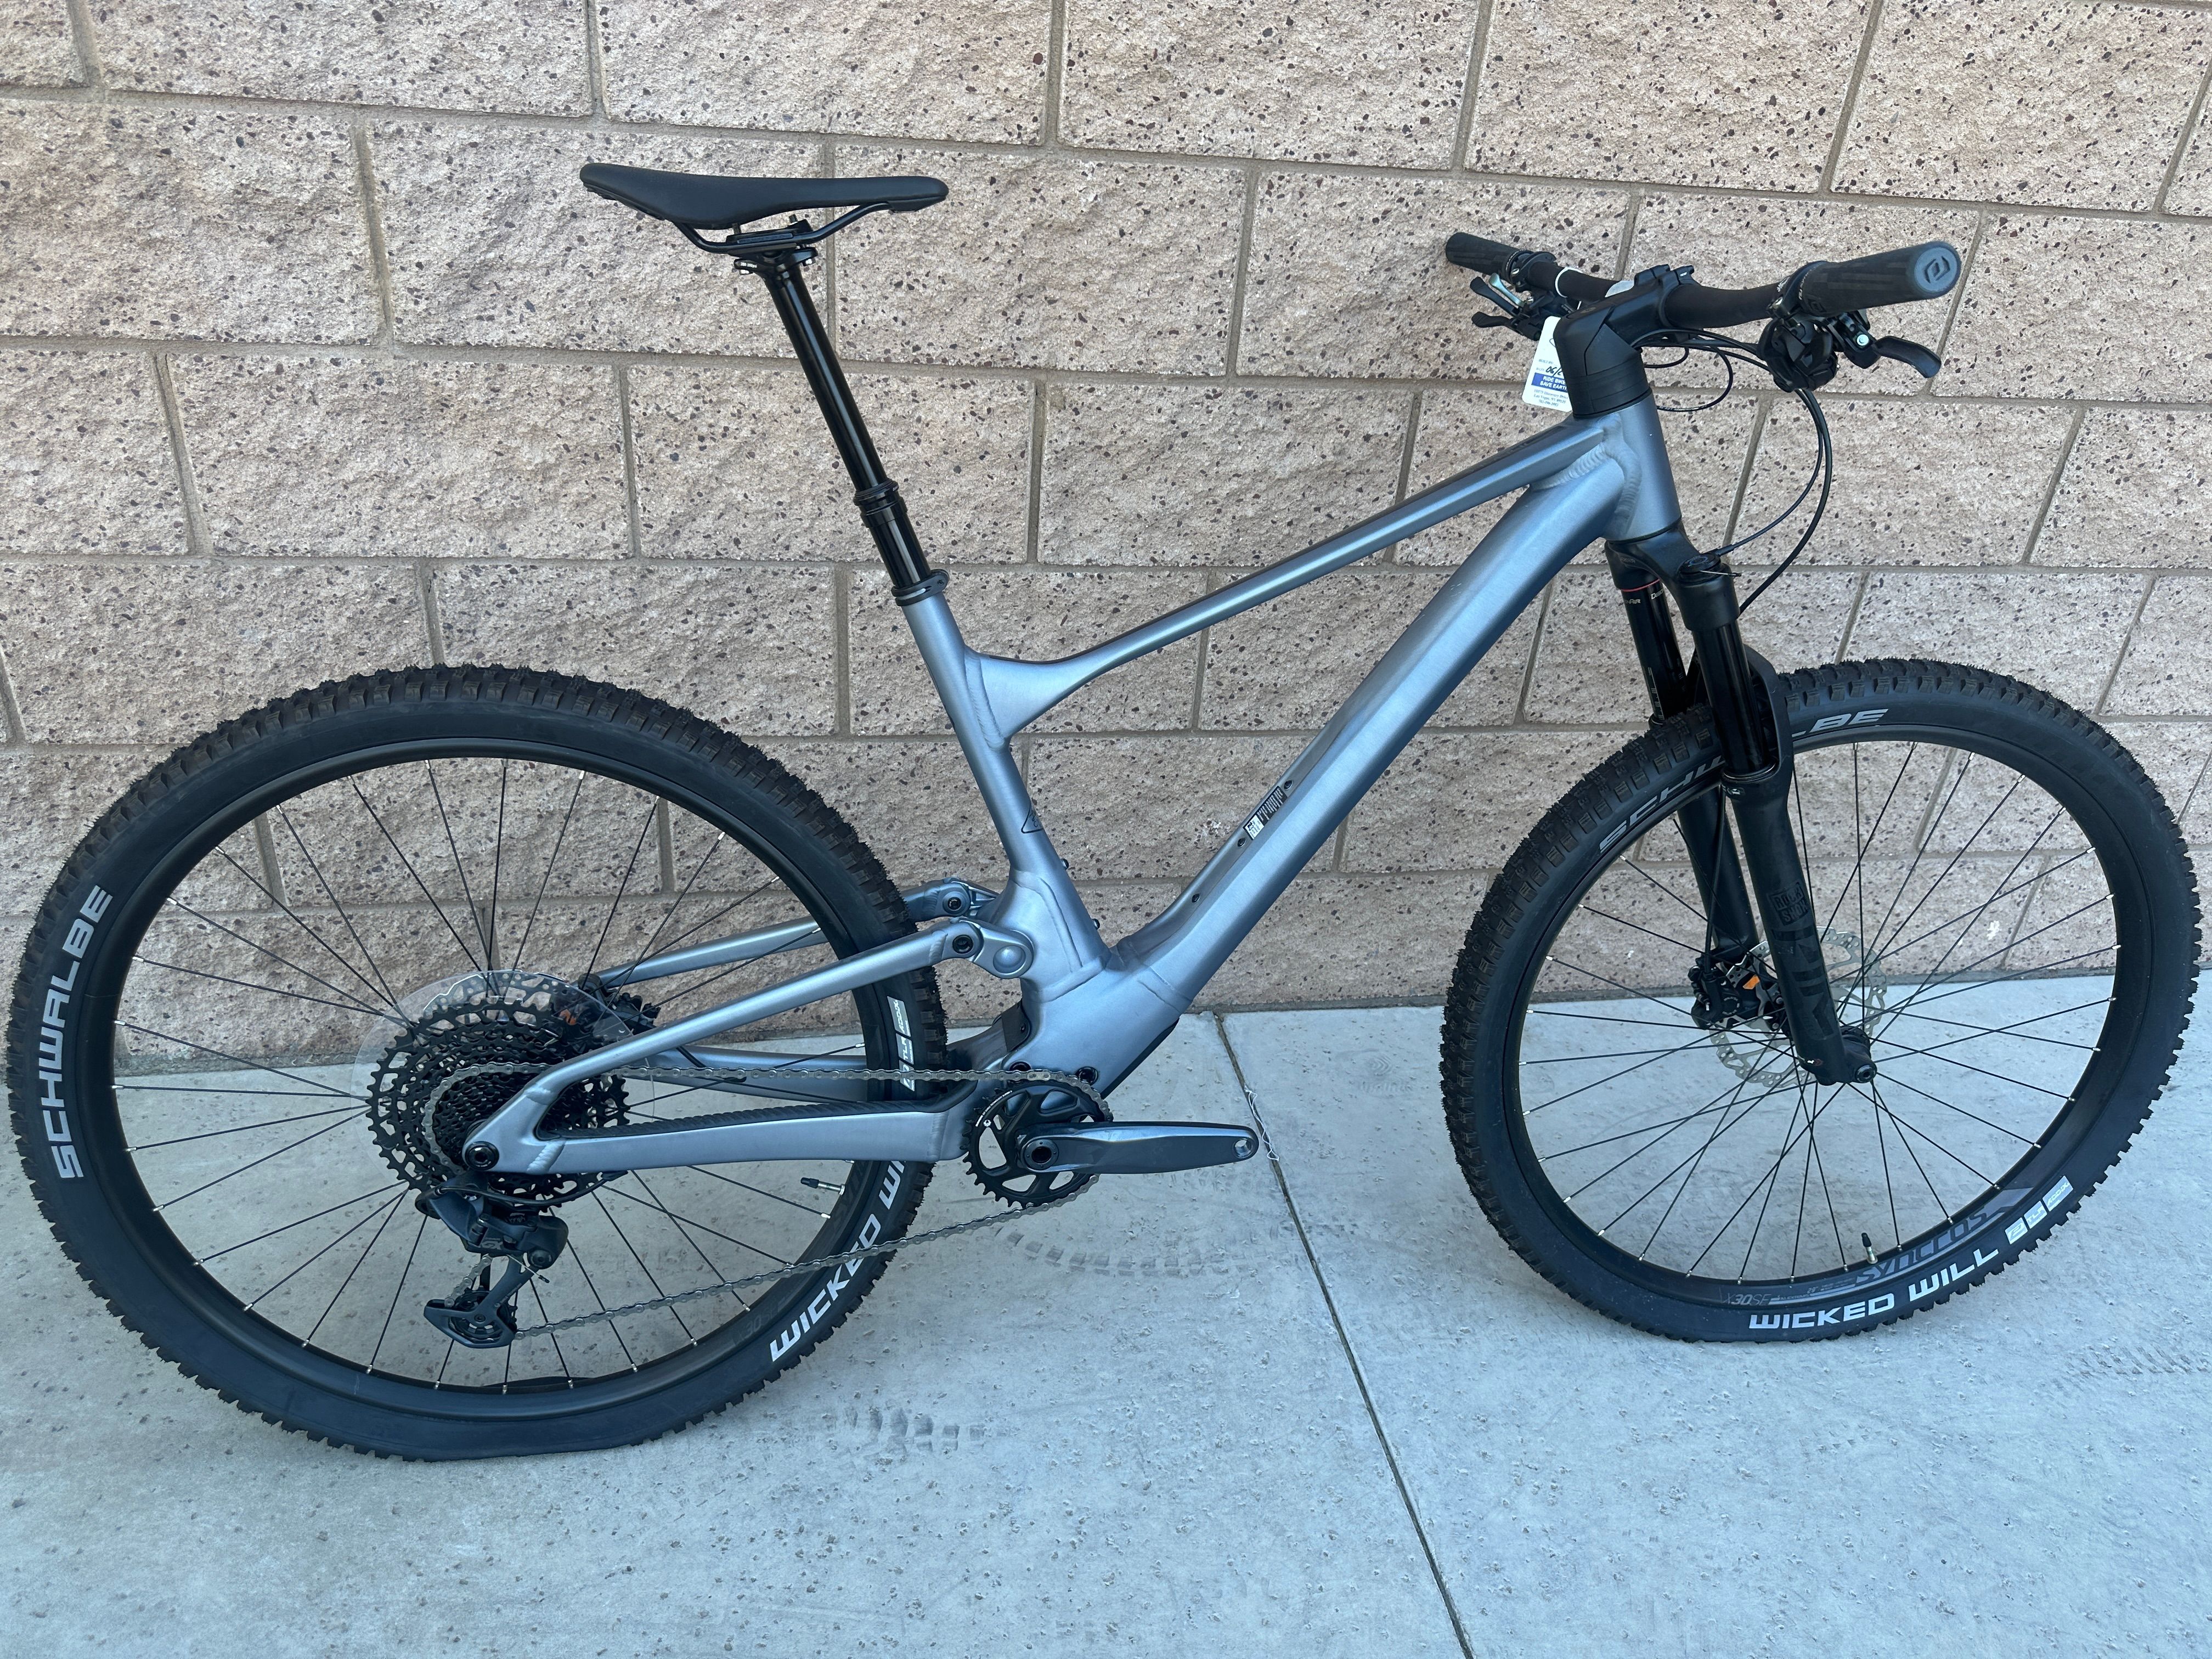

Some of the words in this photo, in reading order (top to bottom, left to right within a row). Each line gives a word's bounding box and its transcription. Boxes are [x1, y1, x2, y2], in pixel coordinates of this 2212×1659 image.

[1599, 708, 1889, 854] SCHWBE
[1774, 884, 1804, 906] ROCK
[1782, 900, 1809, 922] SHOX
[38, 884, 113, 1179] SCHWALBE
[879, 1160, 905, 1210] WI
[770, 1214, 881, 1362] WICKED
[1749, 1293, 1895, 1329] WICKED
[1909, 1248, 1999, 1302] WILL
